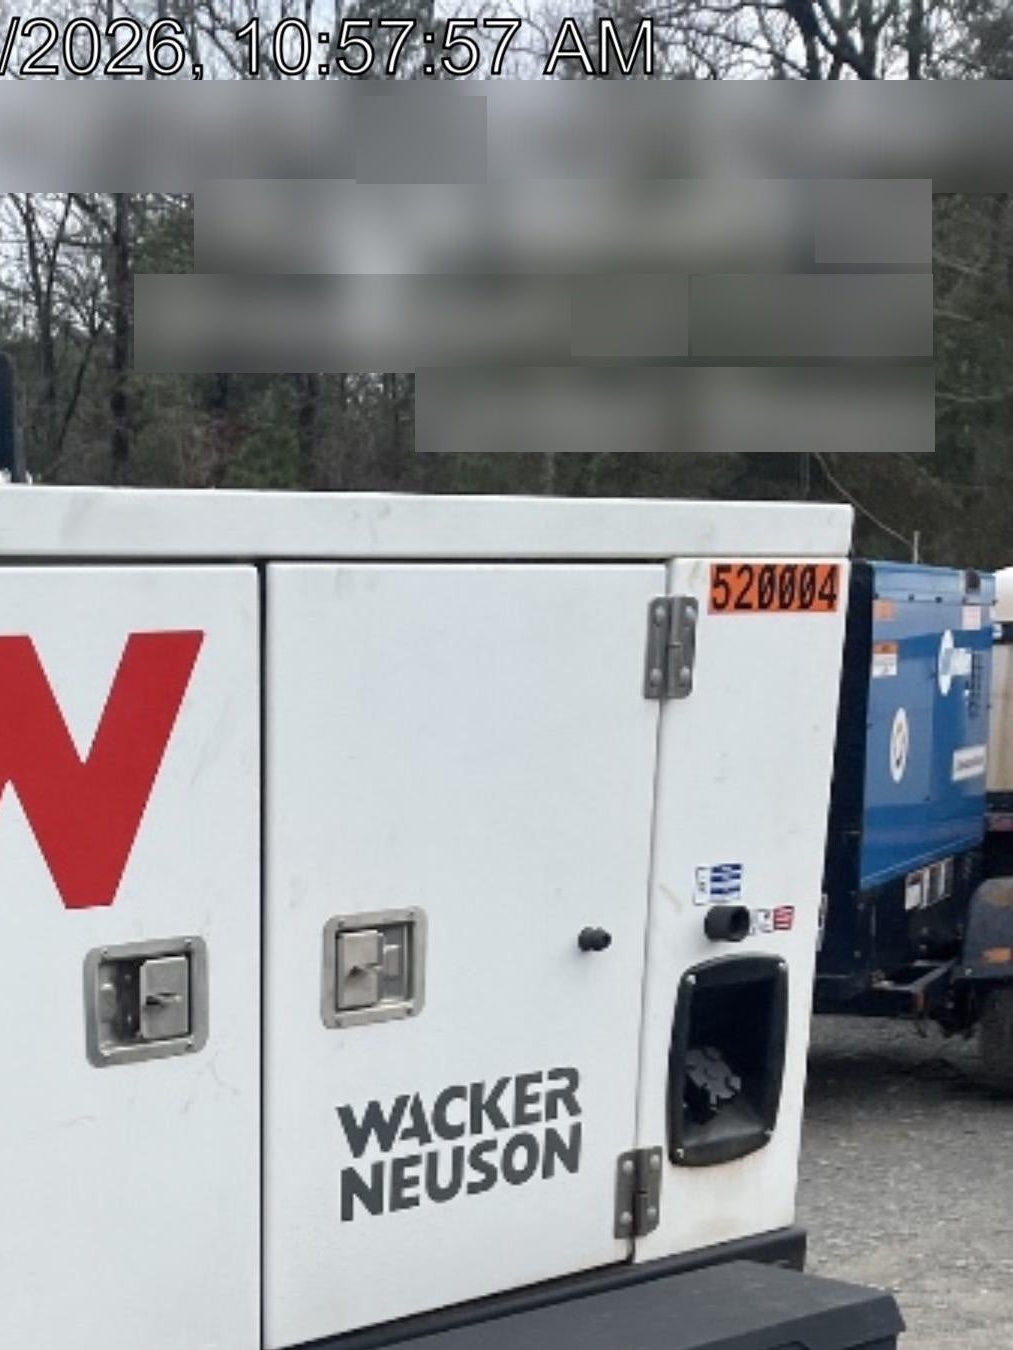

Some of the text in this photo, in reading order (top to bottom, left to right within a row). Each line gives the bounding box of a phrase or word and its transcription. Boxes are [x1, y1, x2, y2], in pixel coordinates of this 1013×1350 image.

[711, 564, 838, 610] 520004
[335, 1067, 583, 1159] WACKER
[340, 1121, 583, 1222] NEUSON
